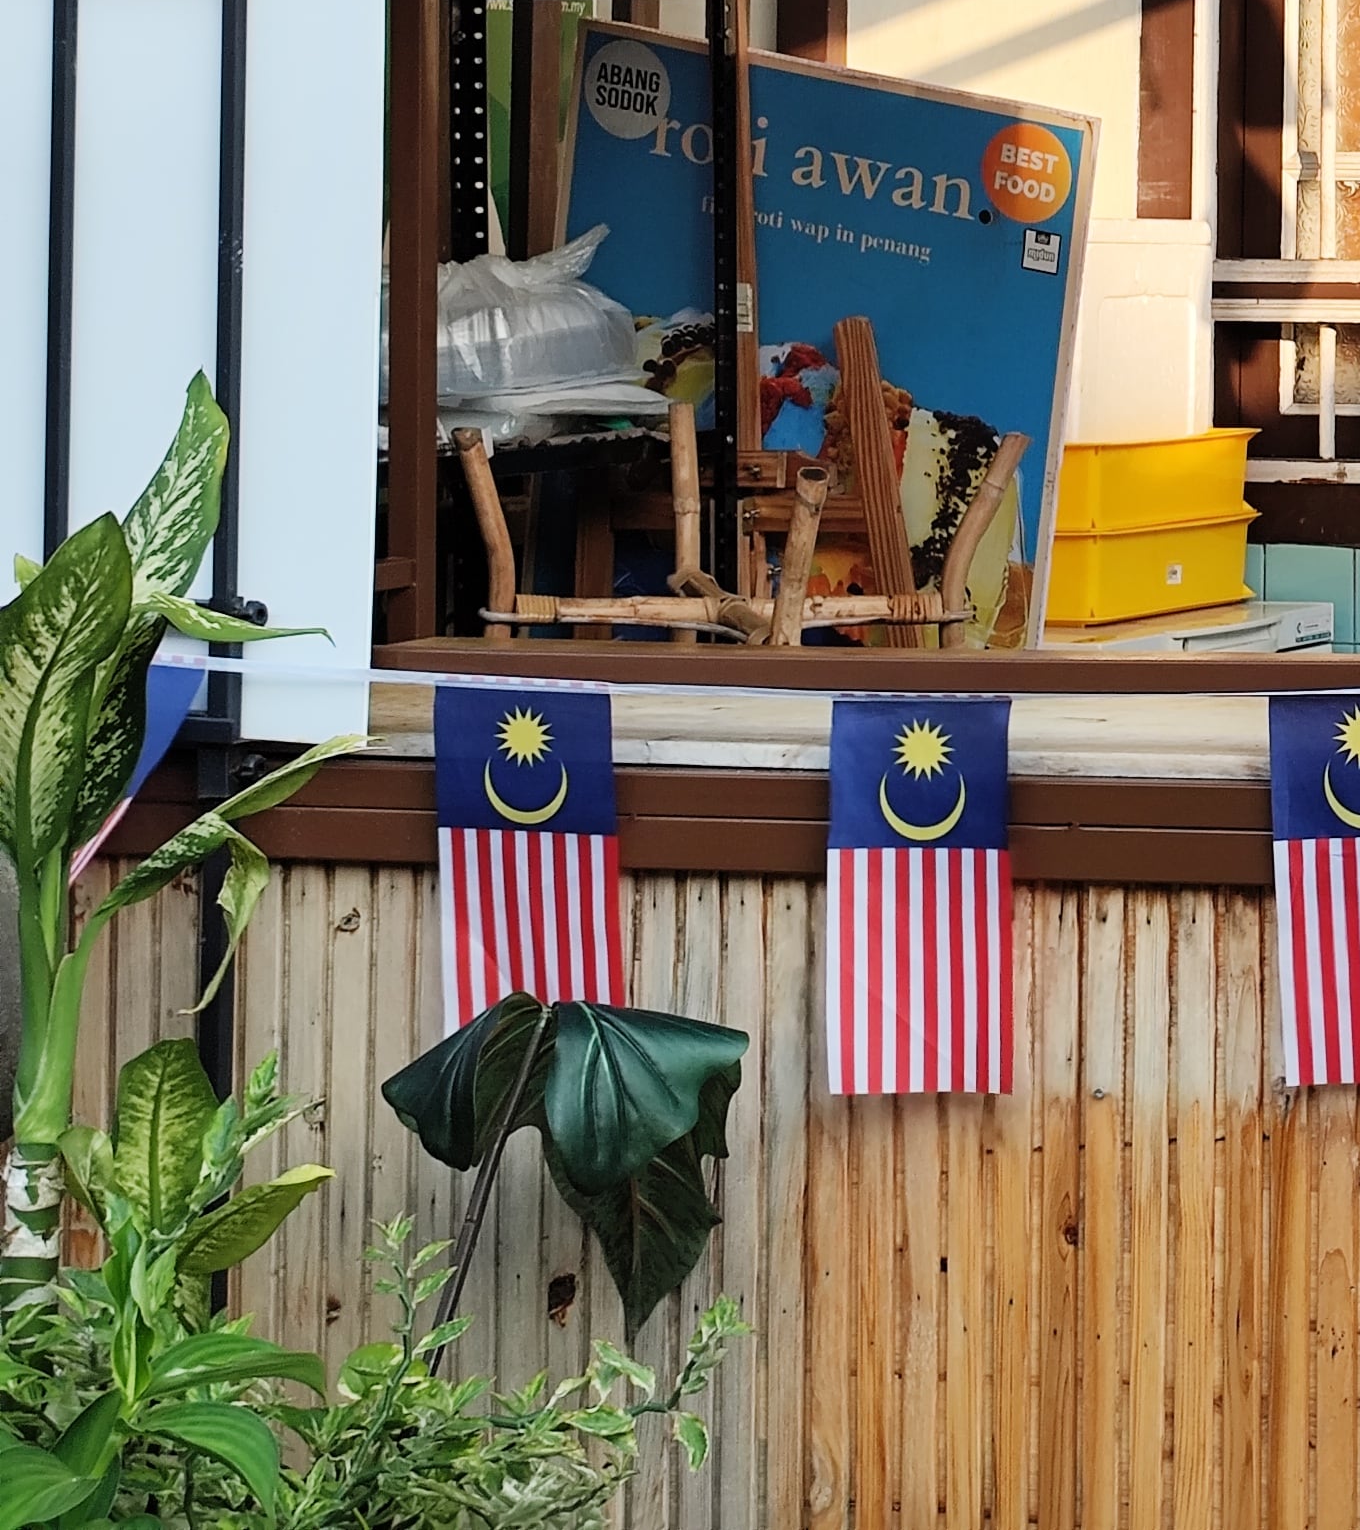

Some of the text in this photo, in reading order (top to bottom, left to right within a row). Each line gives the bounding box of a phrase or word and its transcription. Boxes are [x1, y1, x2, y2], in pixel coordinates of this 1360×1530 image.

[596, 62, 661, 93] ABANG
[595, 85, 659, 116] SODOK
[649, 116, 975, 221] roi awan
[1000, 143, 1059, 174] BEST
[994, 170, 1056, 203] FOOD
[754, 211, 932, 263] oti wap in penang
